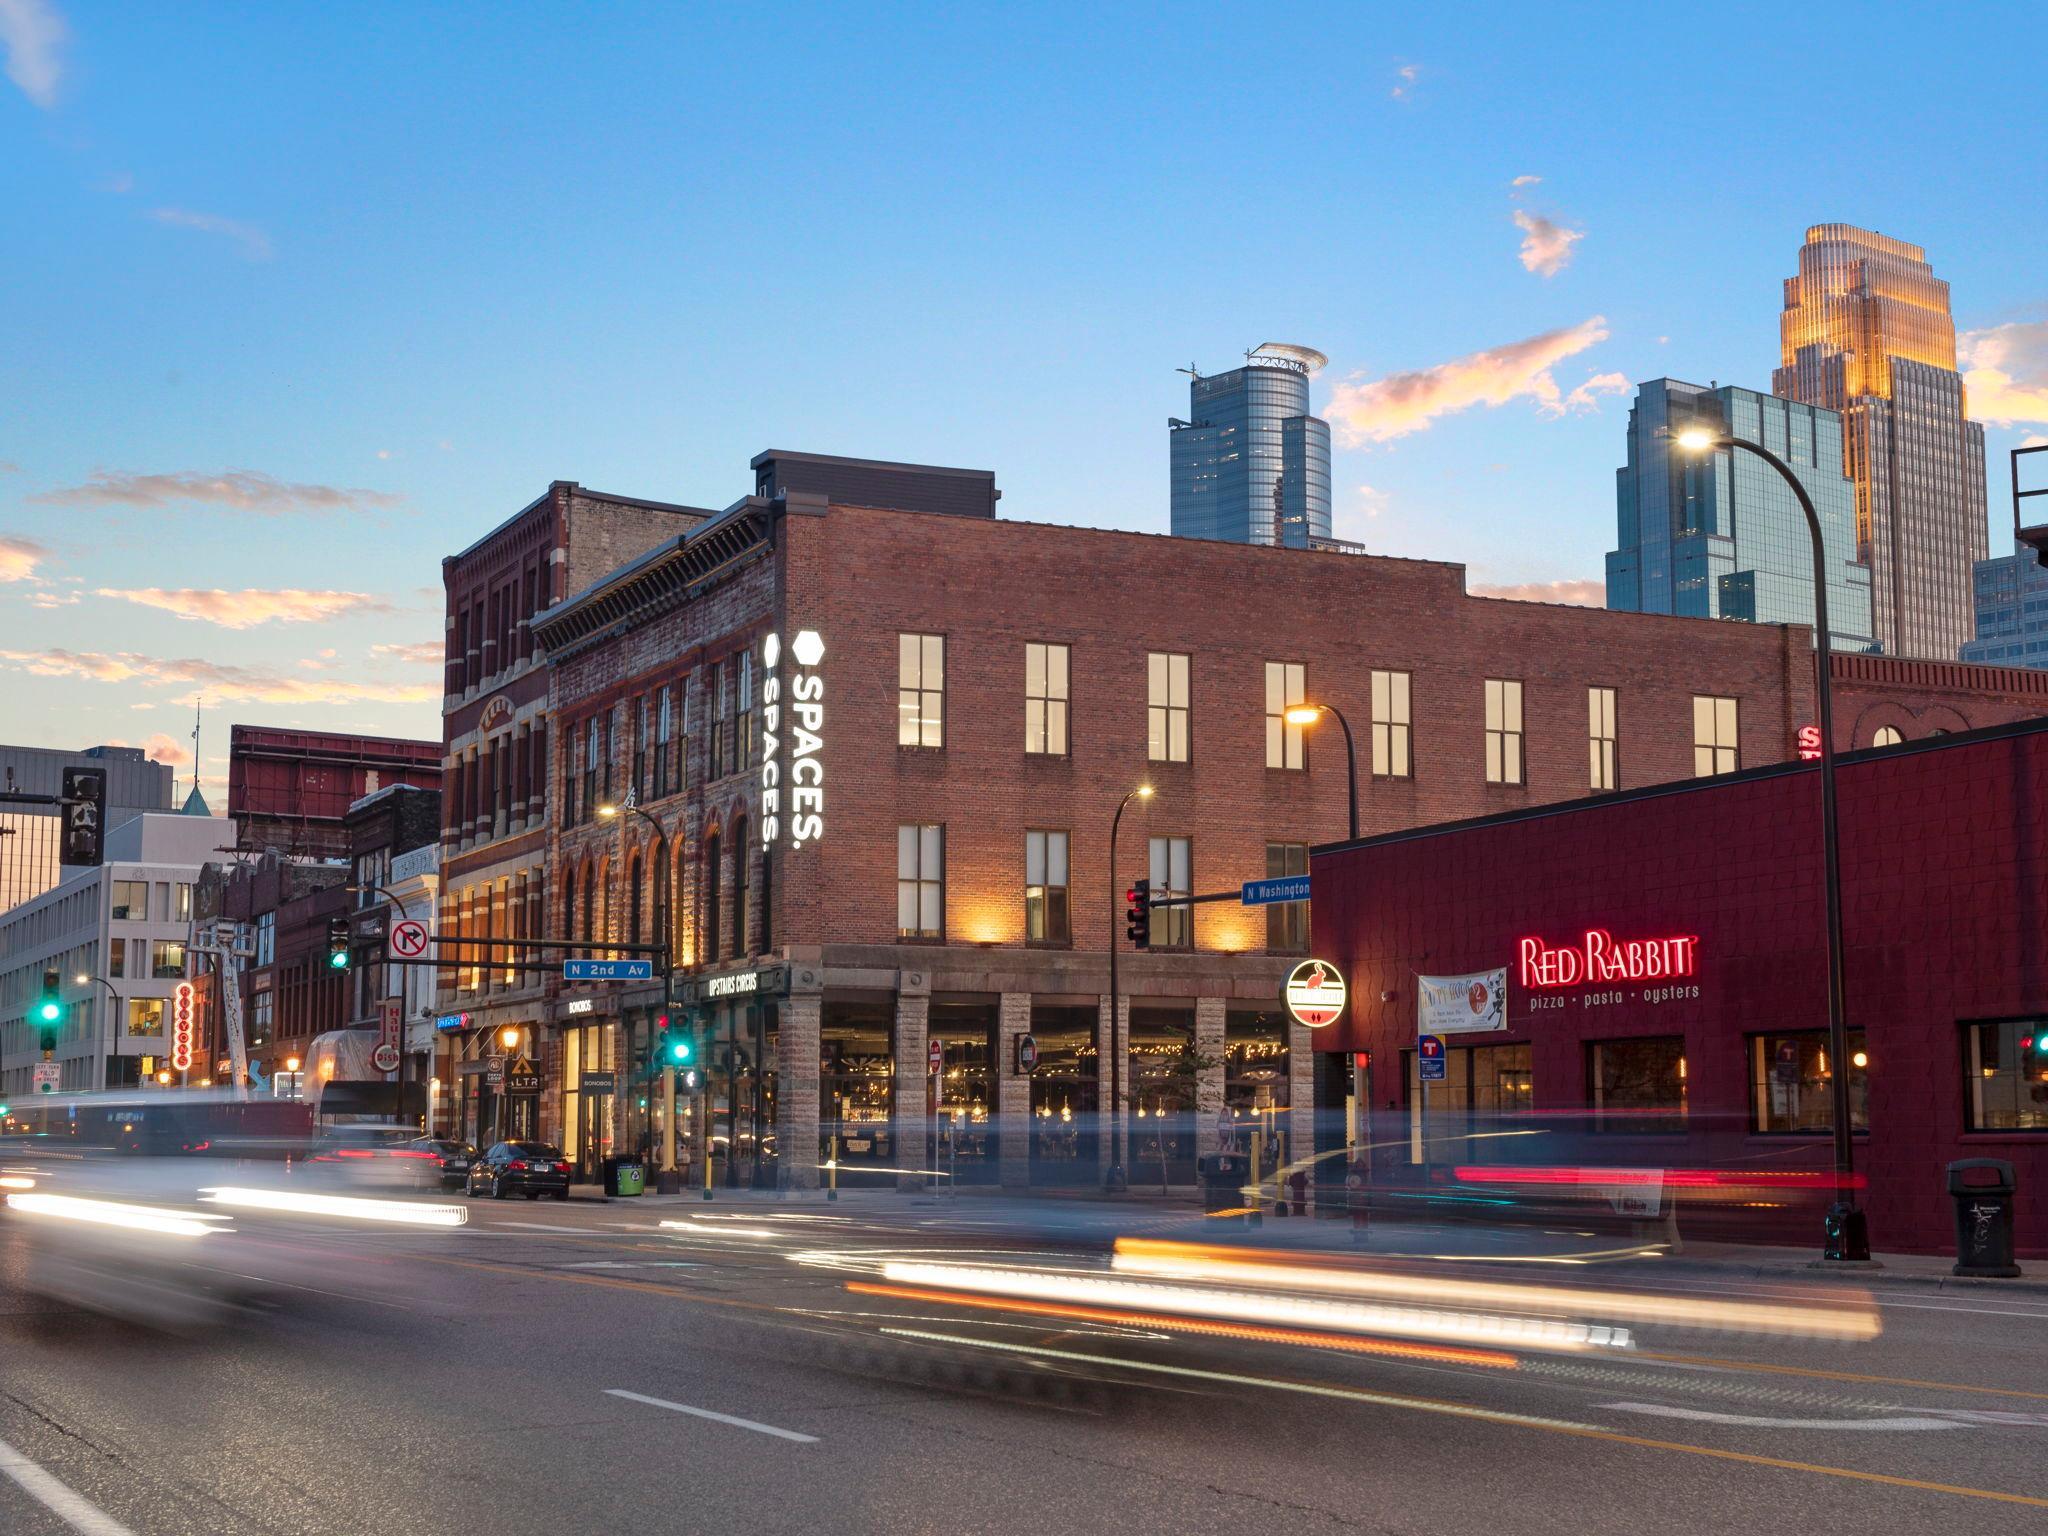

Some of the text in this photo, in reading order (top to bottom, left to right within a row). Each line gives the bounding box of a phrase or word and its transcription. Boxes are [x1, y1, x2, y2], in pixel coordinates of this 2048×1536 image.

[762, 677, 780, 852] SPACES.
[792, 674, 824, 850] SPACES.
[1248, 882, 1310, 900] N Washington
[571, 964, 644, 975] N 2nd Av
[709, 972, 757, 997] UPSTAIRS CIRCUS
[568, 999, 592, 1014] BONOBOS
[1530, 985, 1699, 1013] pizza pasta oysters
[376, 1052, 399, 1062] Dish
